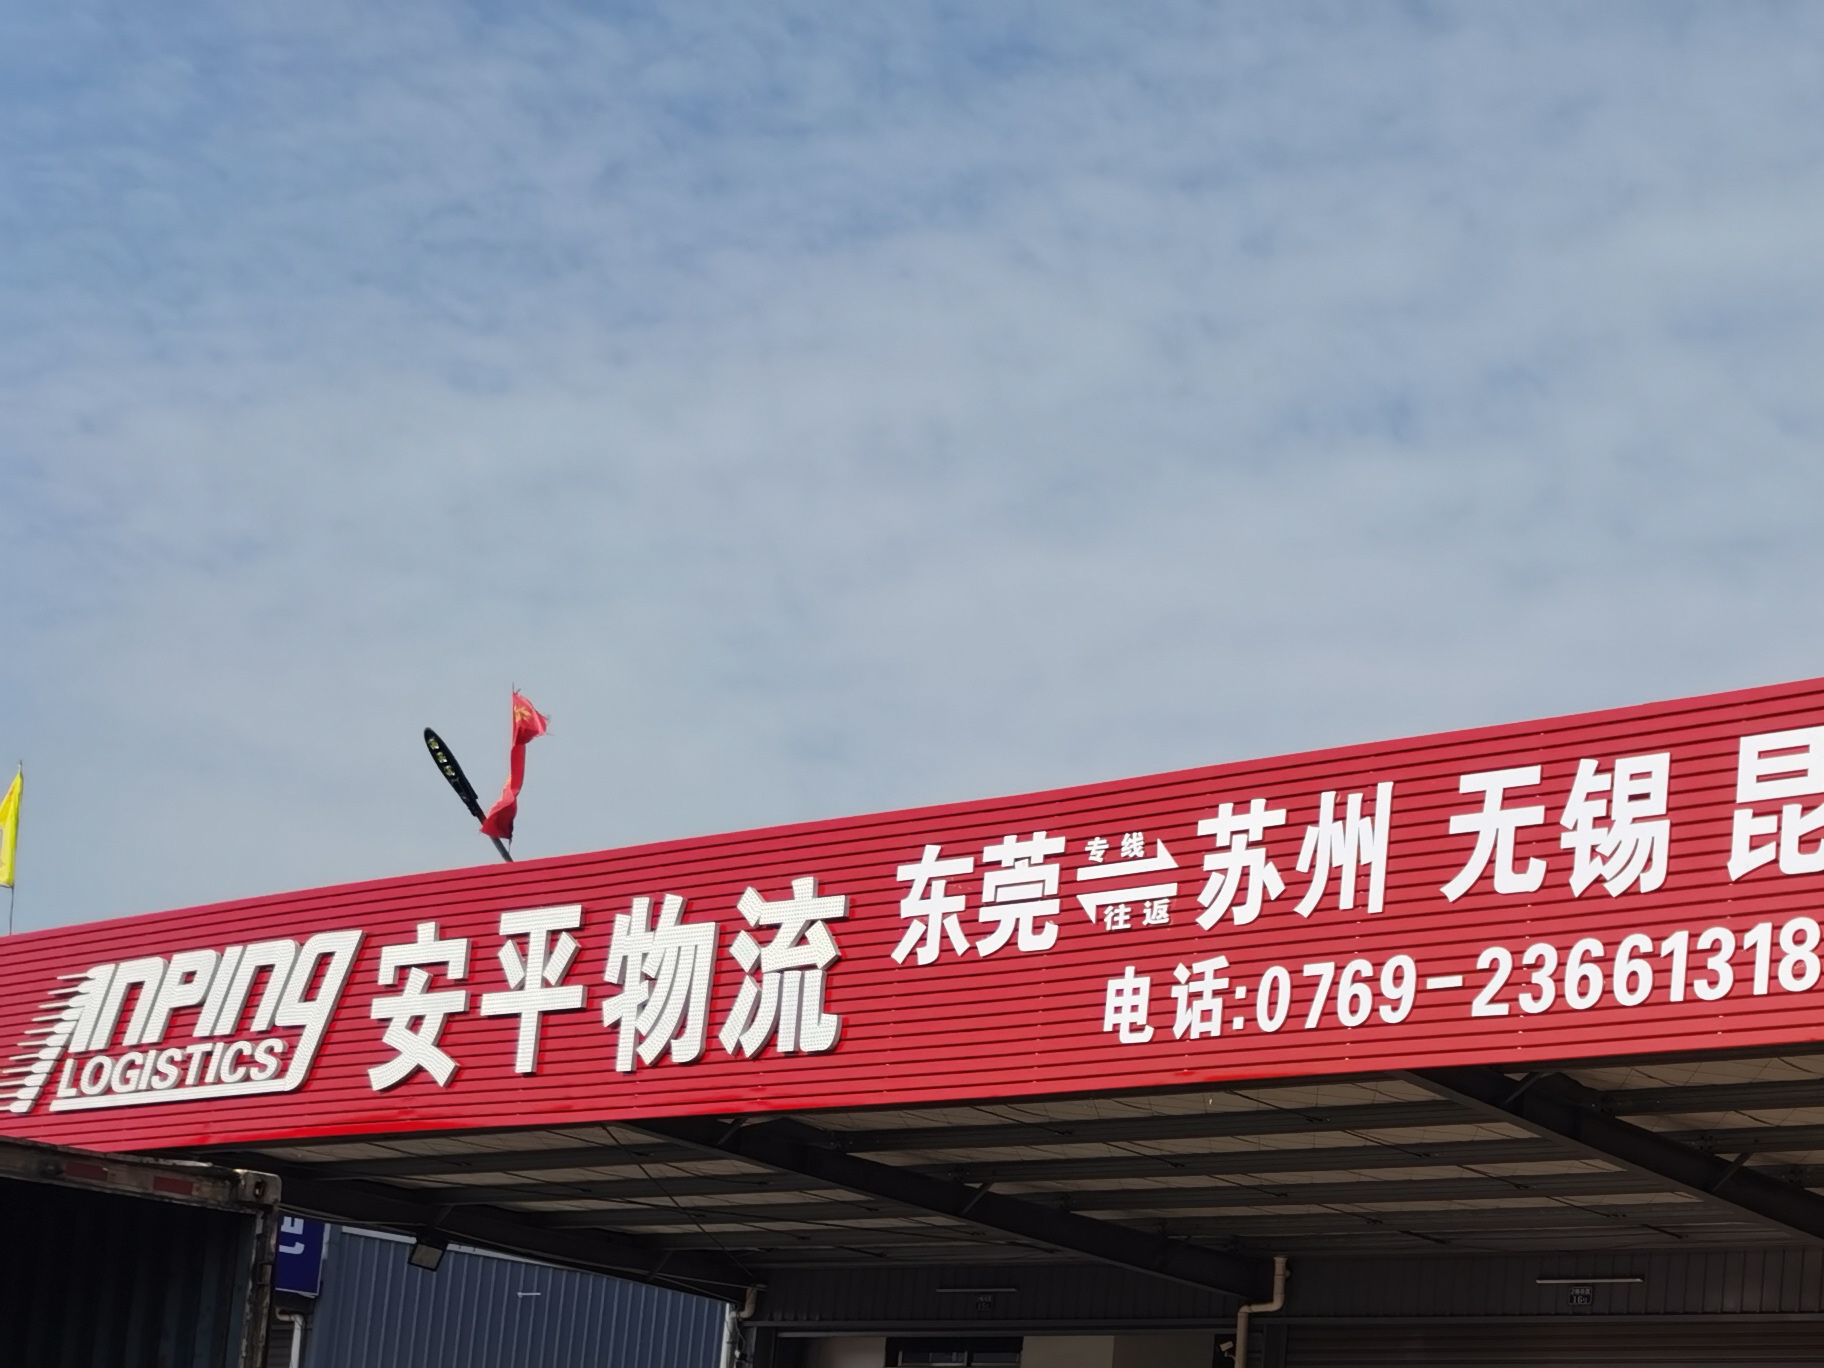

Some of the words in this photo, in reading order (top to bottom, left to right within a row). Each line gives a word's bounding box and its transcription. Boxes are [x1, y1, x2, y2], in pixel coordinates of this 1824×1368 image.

[1085, 832, 1145, 863] 专线
[1197, 781, 1395, 931] 苏州
[1441, 752, 1672, 903] 无锡
[892, 831, 1066, 966] 东莞
[1103, 898, 1171, 932] 往返
[367, 876, 848, 1091] 安平物流
[57, 1038, 286, 1098] LOGISTICS
